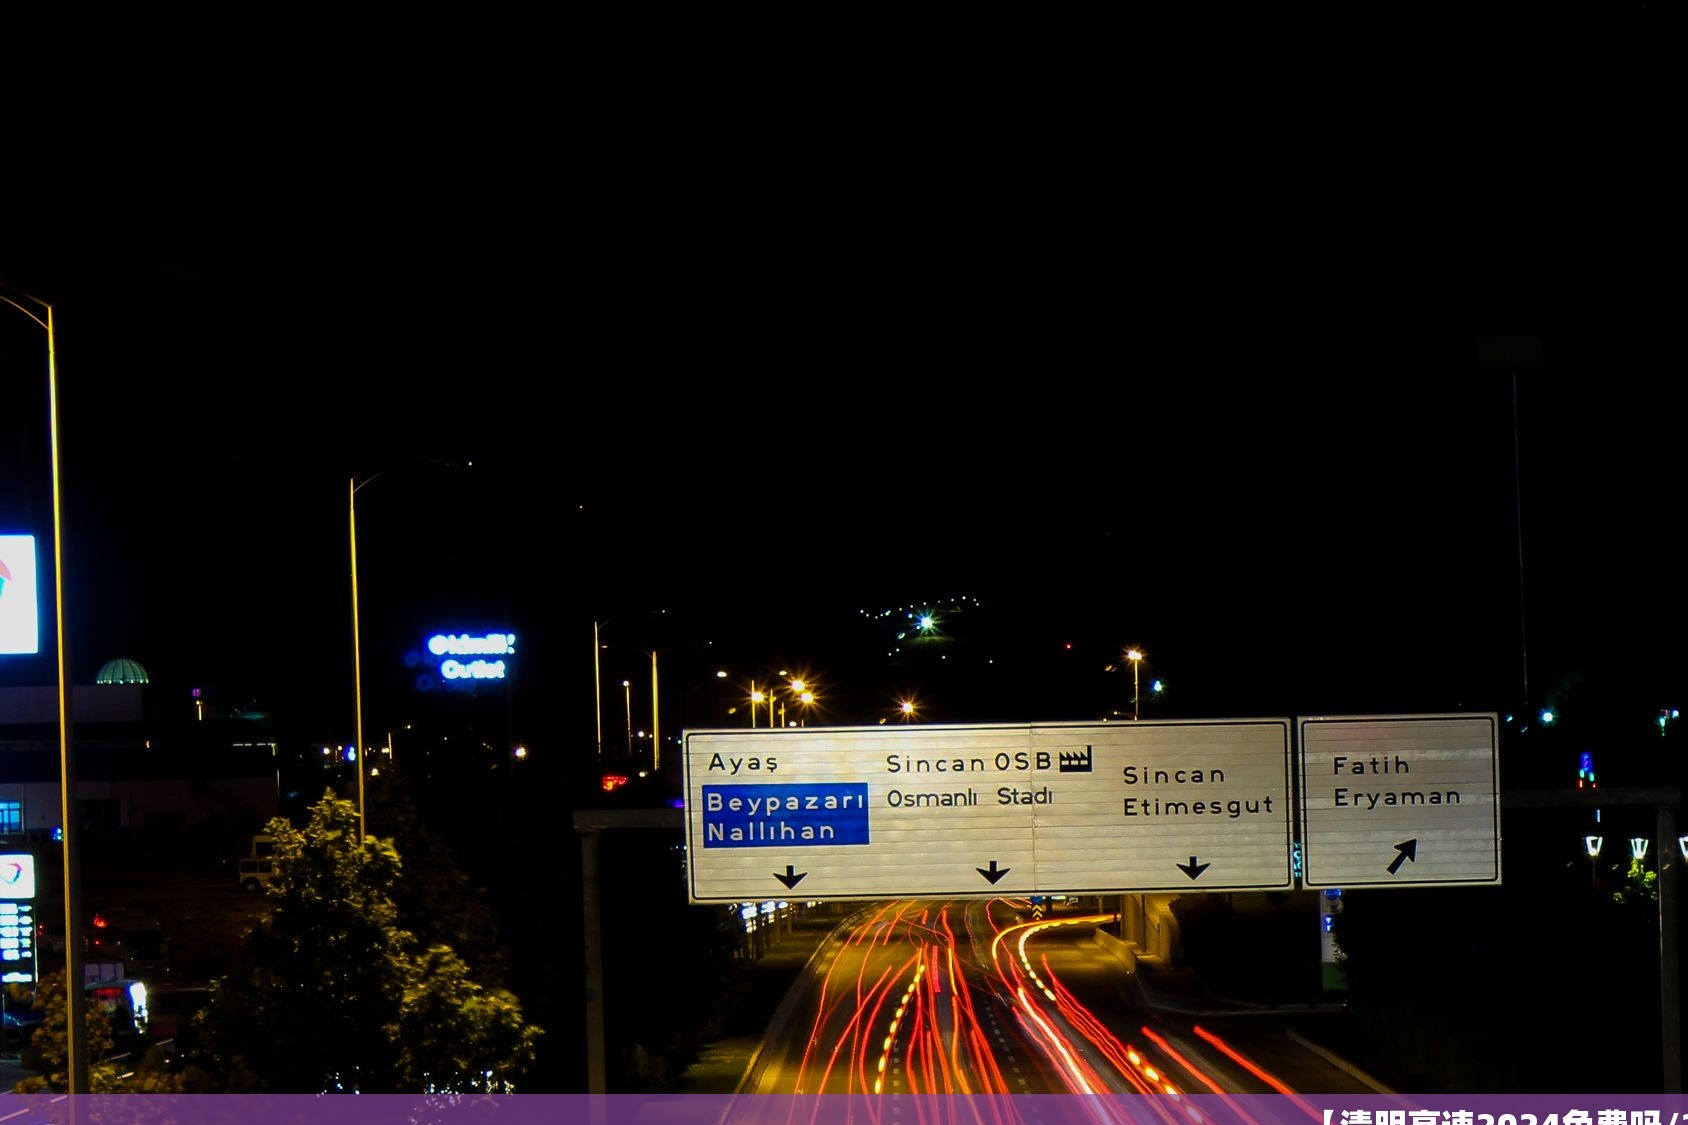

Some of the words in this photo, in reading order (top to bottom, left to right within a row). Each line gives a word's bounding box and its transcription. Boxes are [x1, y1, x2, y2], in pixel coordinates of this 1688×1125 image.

[708, 752, 778, 775] Ayaş
[886, 755, 985, 773] Sincan
[994, 751, 1051, 771] OSB
[1333, 755, 1410, 775] Fatih
[1123, 766, 1225, 785] Sincan
[707, 792, 863, 816] Beypazarı
[887, 788, 978, 807] Osmanlı
[997, 786, 1053, 805] Stadı
[1123, 796, 1273, 818] Etimesgut
[1334, 788, 1461, 810] Eryaman
[707, 821, 835, 841] Nallıhan
